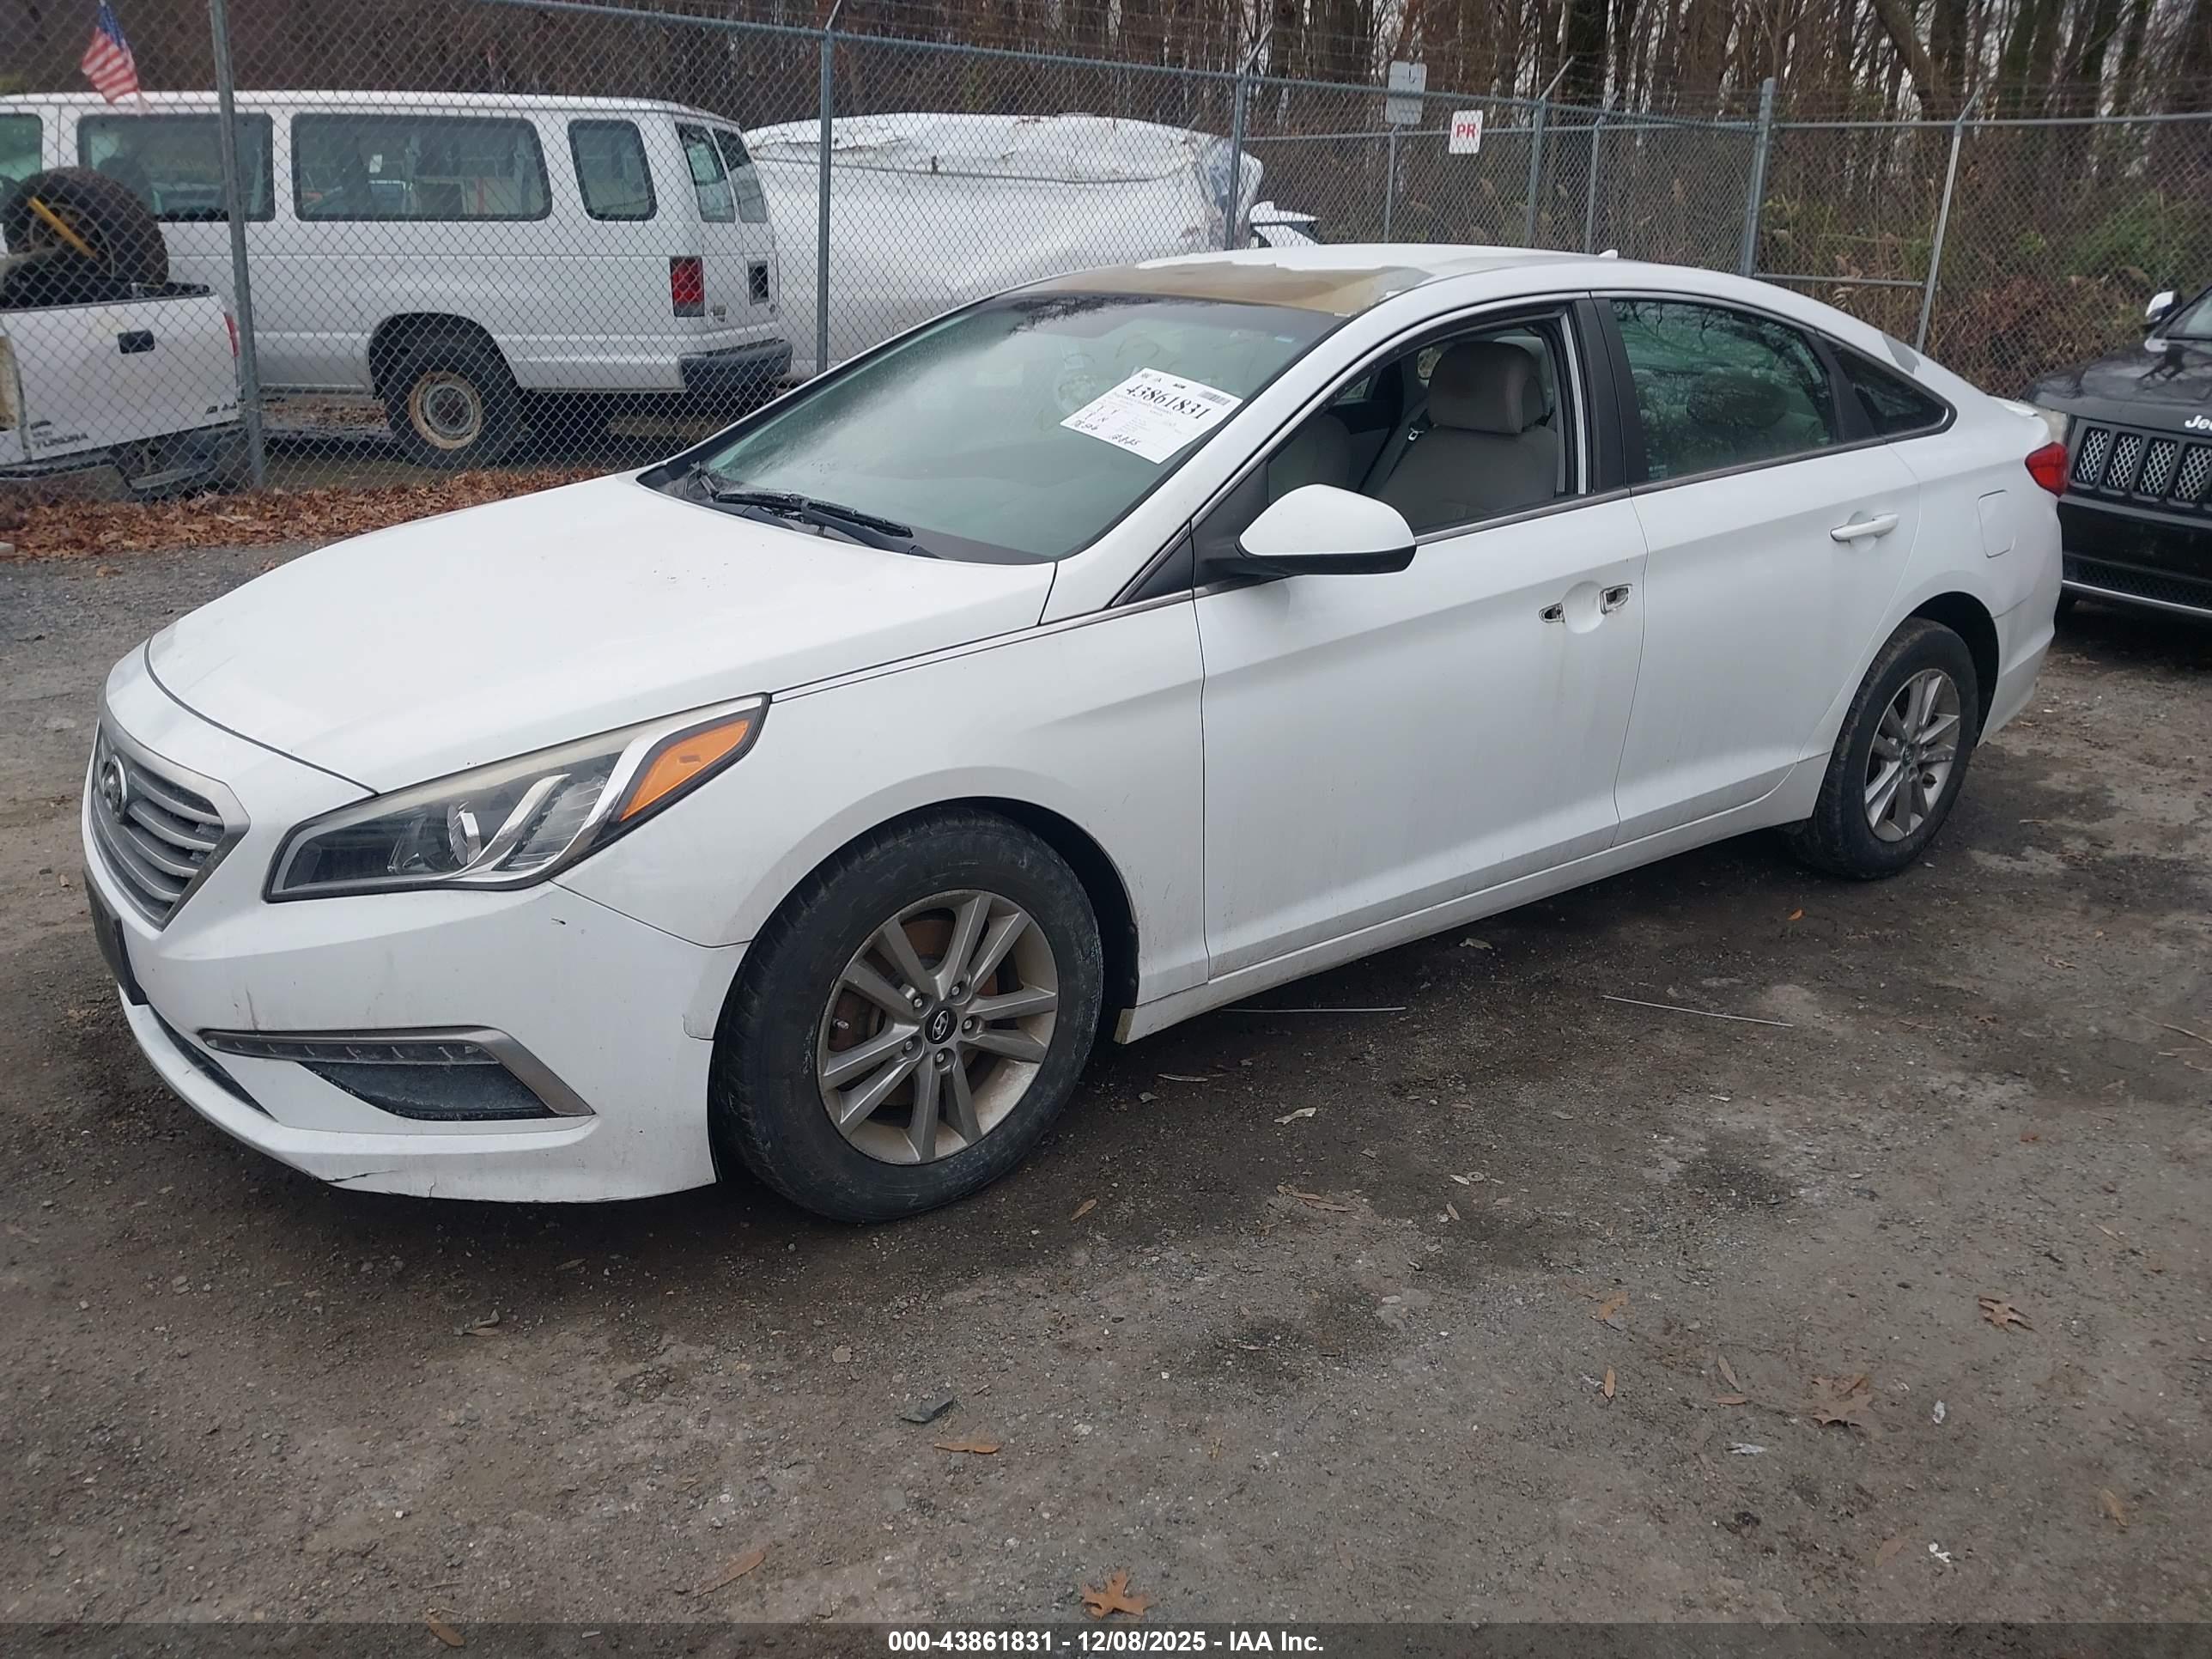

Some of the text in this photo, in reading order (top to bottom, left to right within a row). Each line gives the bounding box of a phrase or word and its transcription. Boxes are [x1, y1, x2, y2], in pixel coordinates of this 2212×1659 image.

[1456, 123, 1476, 139] PR
[1125, 384, 1211, 420] 43861831
[2184, 414, 2212, 431] Je
